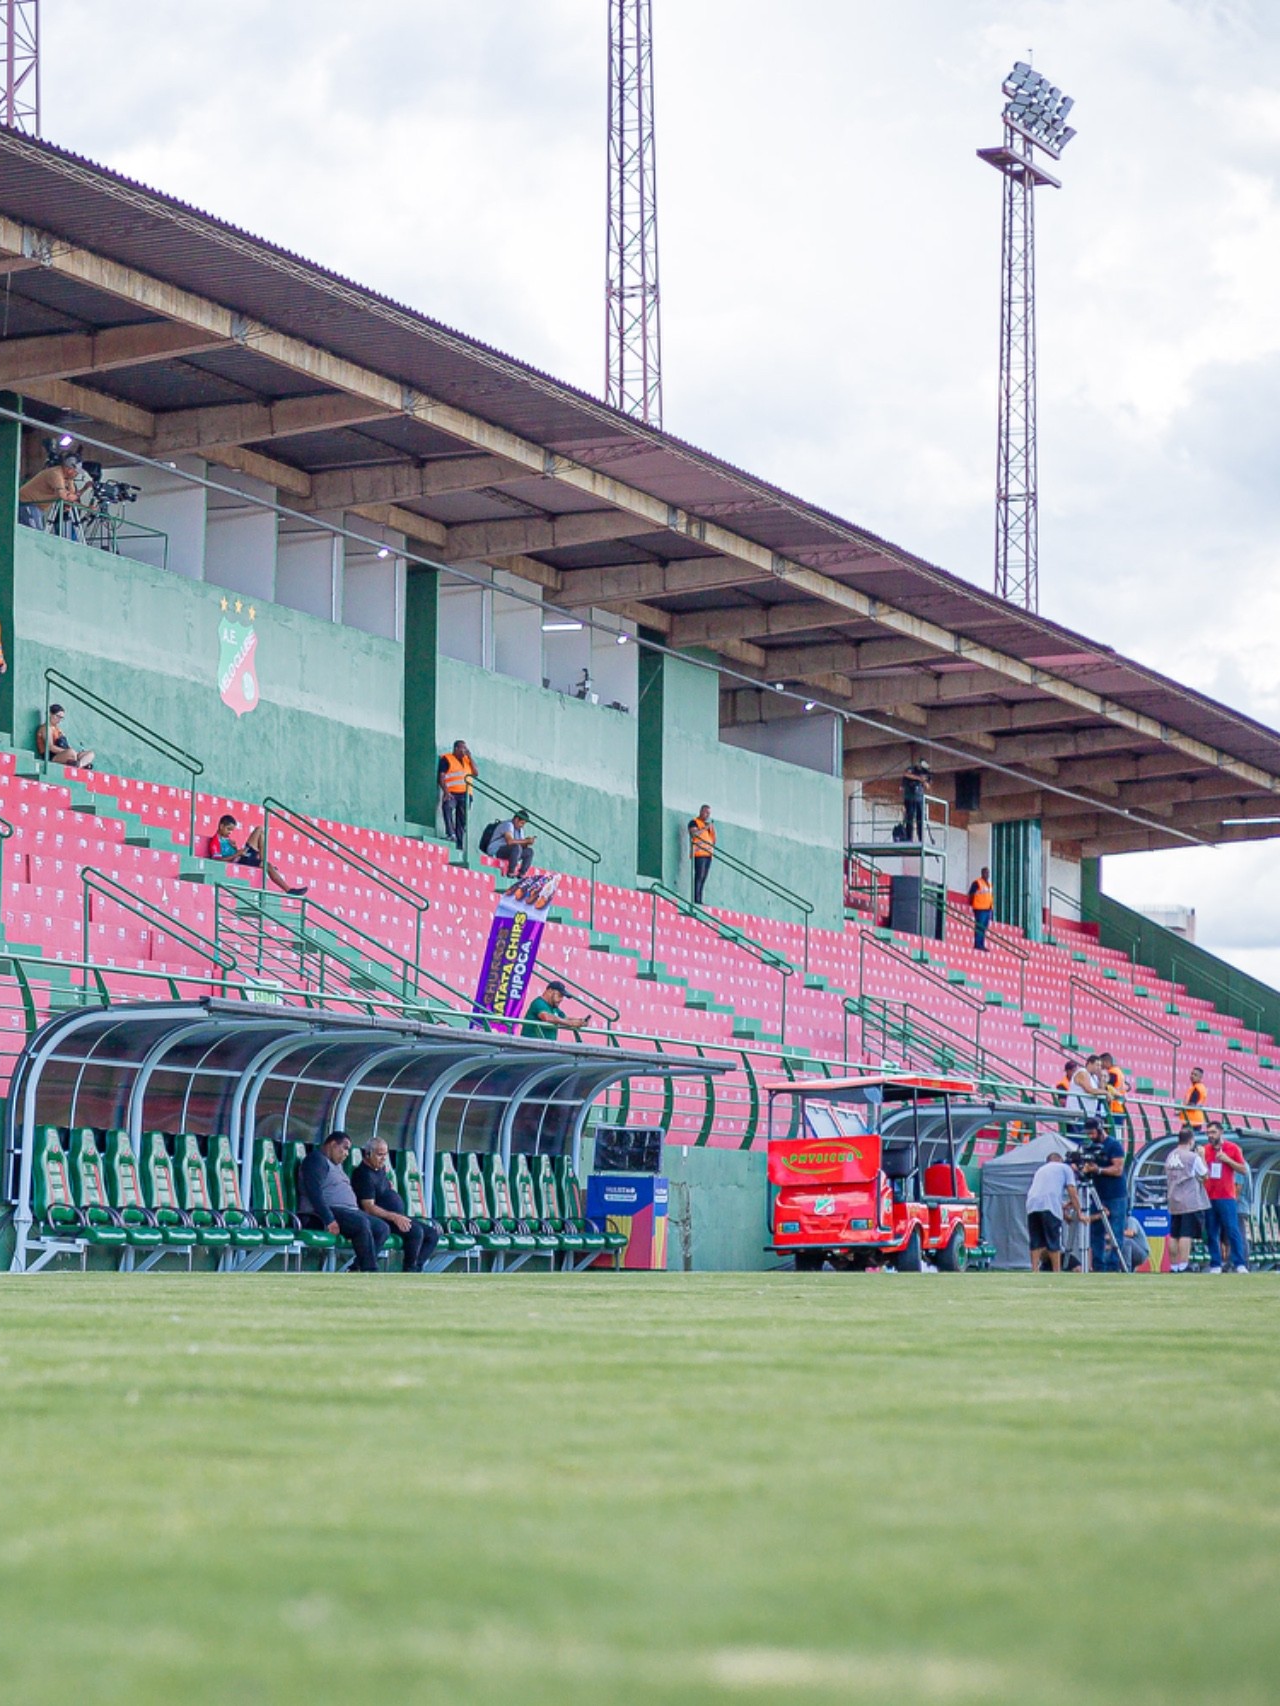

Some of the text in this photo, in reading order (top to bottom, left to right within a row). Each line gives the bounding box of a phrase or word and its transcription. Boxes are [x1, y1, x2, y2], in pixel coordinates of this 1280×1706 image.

[493, 912, 527, 1017] ATATA CHIPS
[510, 940, 533, 1000] PIPOCA
